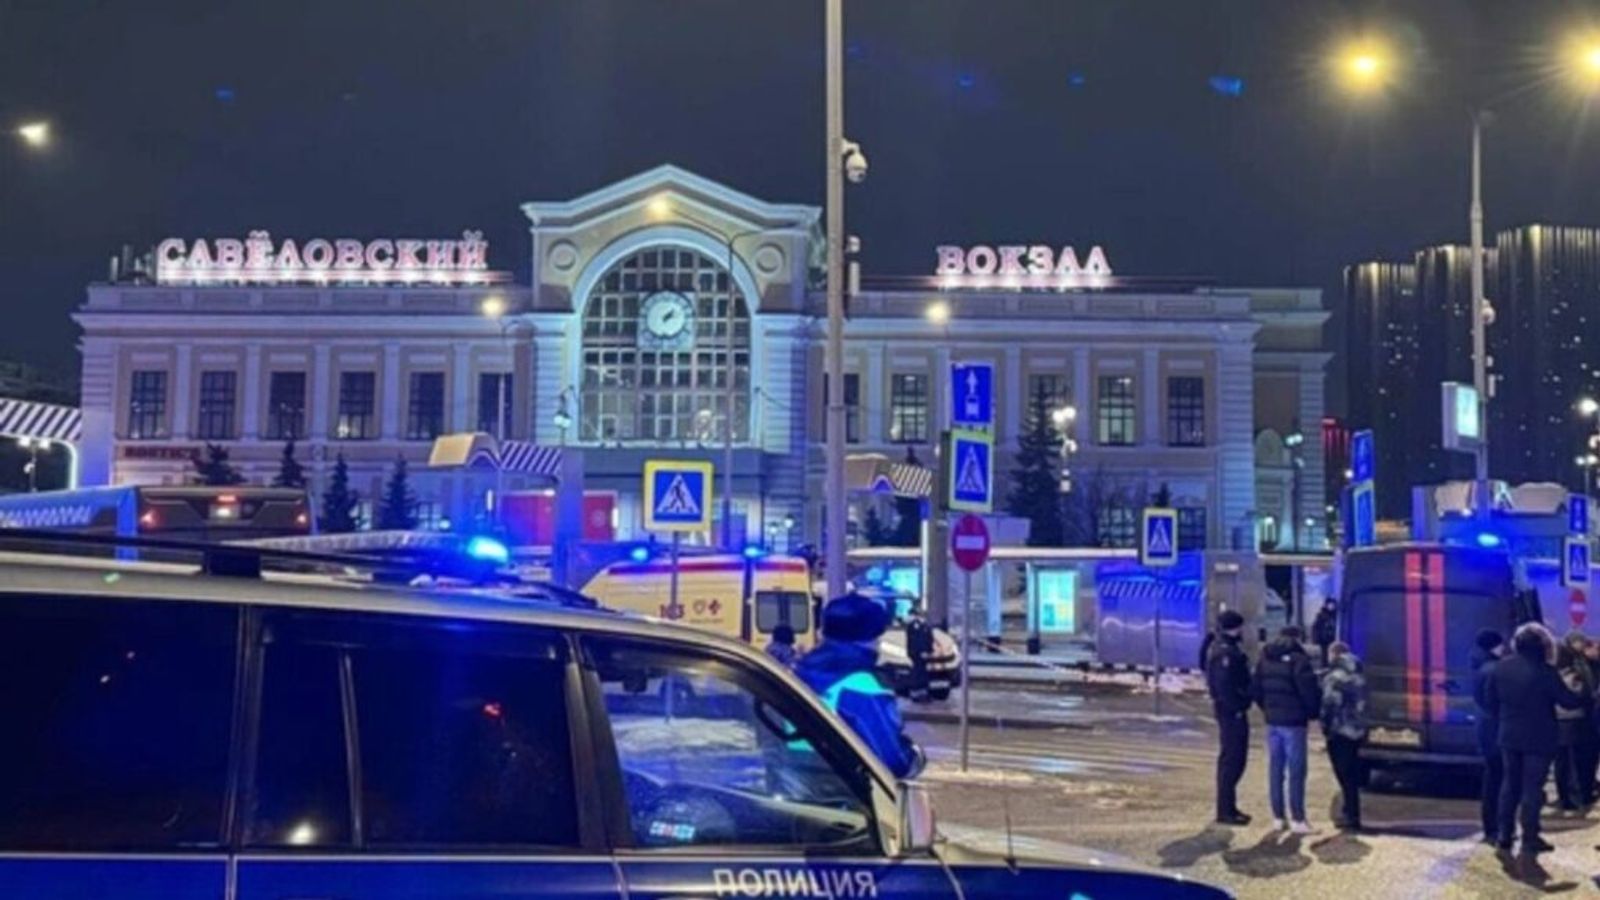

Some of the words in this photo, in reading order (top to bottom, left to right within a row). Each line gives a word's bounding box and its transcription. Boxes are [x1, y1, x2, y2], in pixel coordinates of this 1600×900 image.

[157, 229, 488, 270] САВЁЛОВСКИЙ
[935, 245, 1112, 275] ВОКЗАЛ
[712, 868, 878, 900] ПОЛИЦИЯ
